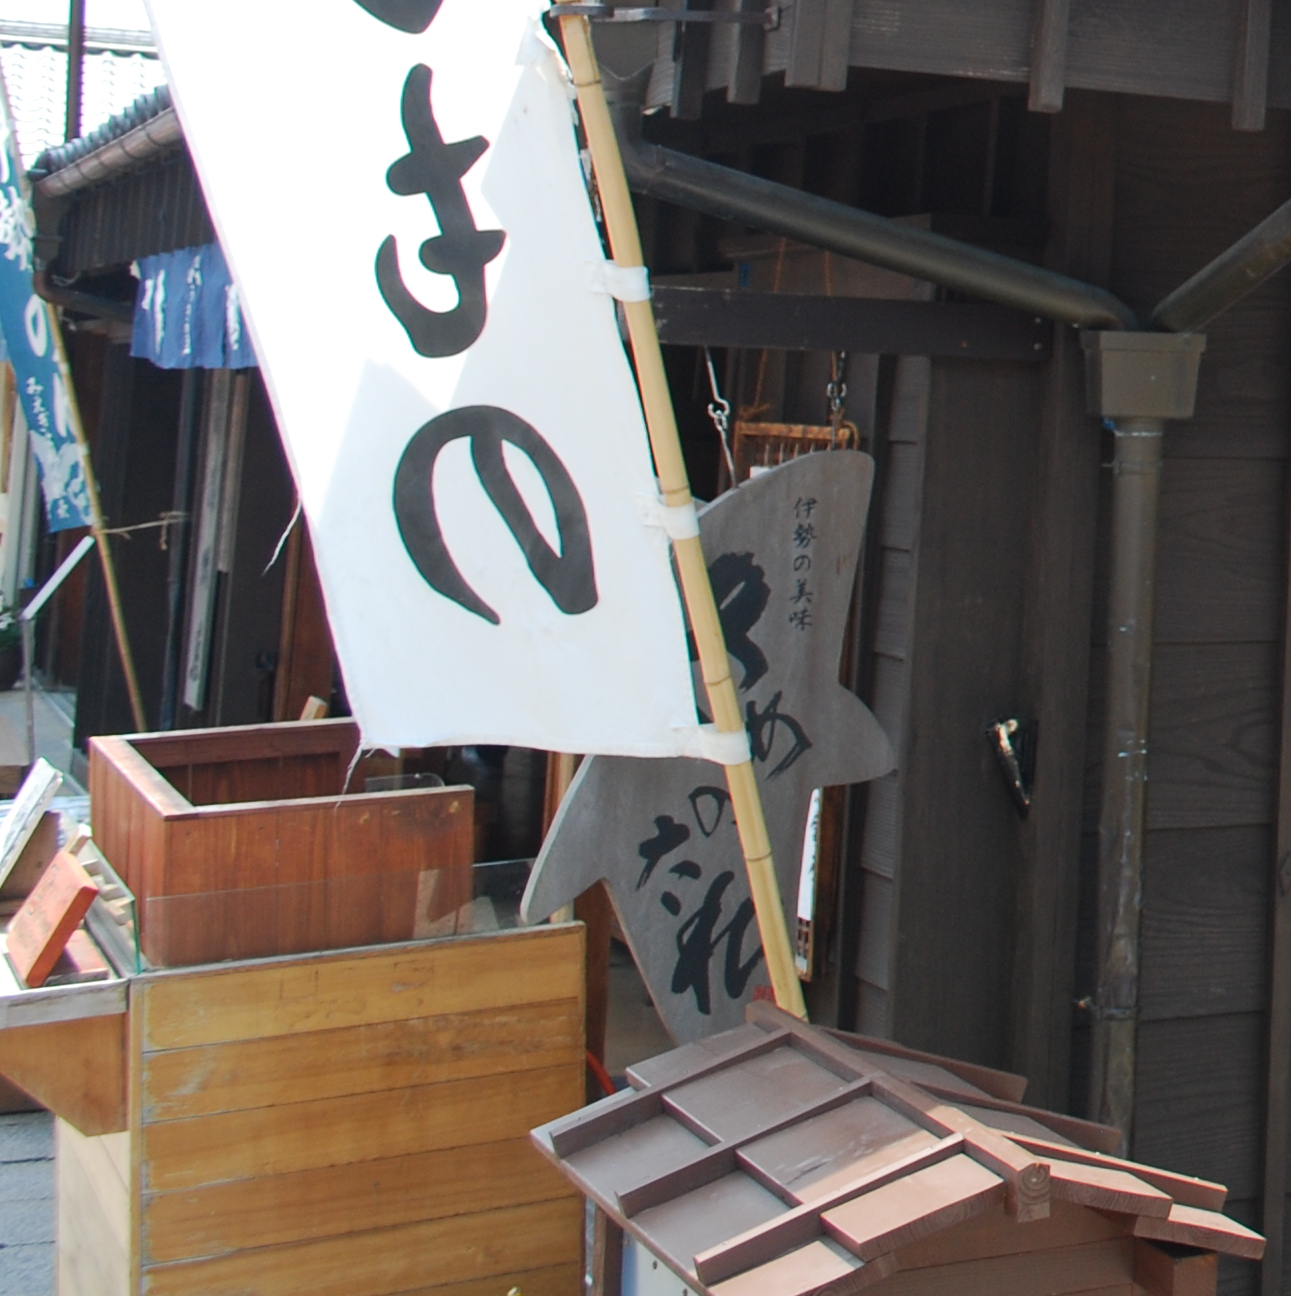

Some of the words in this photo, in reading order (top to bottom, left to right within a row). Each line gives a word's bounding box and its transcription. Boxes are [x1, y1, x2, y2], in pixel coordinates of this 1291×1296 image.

[786, 495, 818, 631] 伊勢の美味
